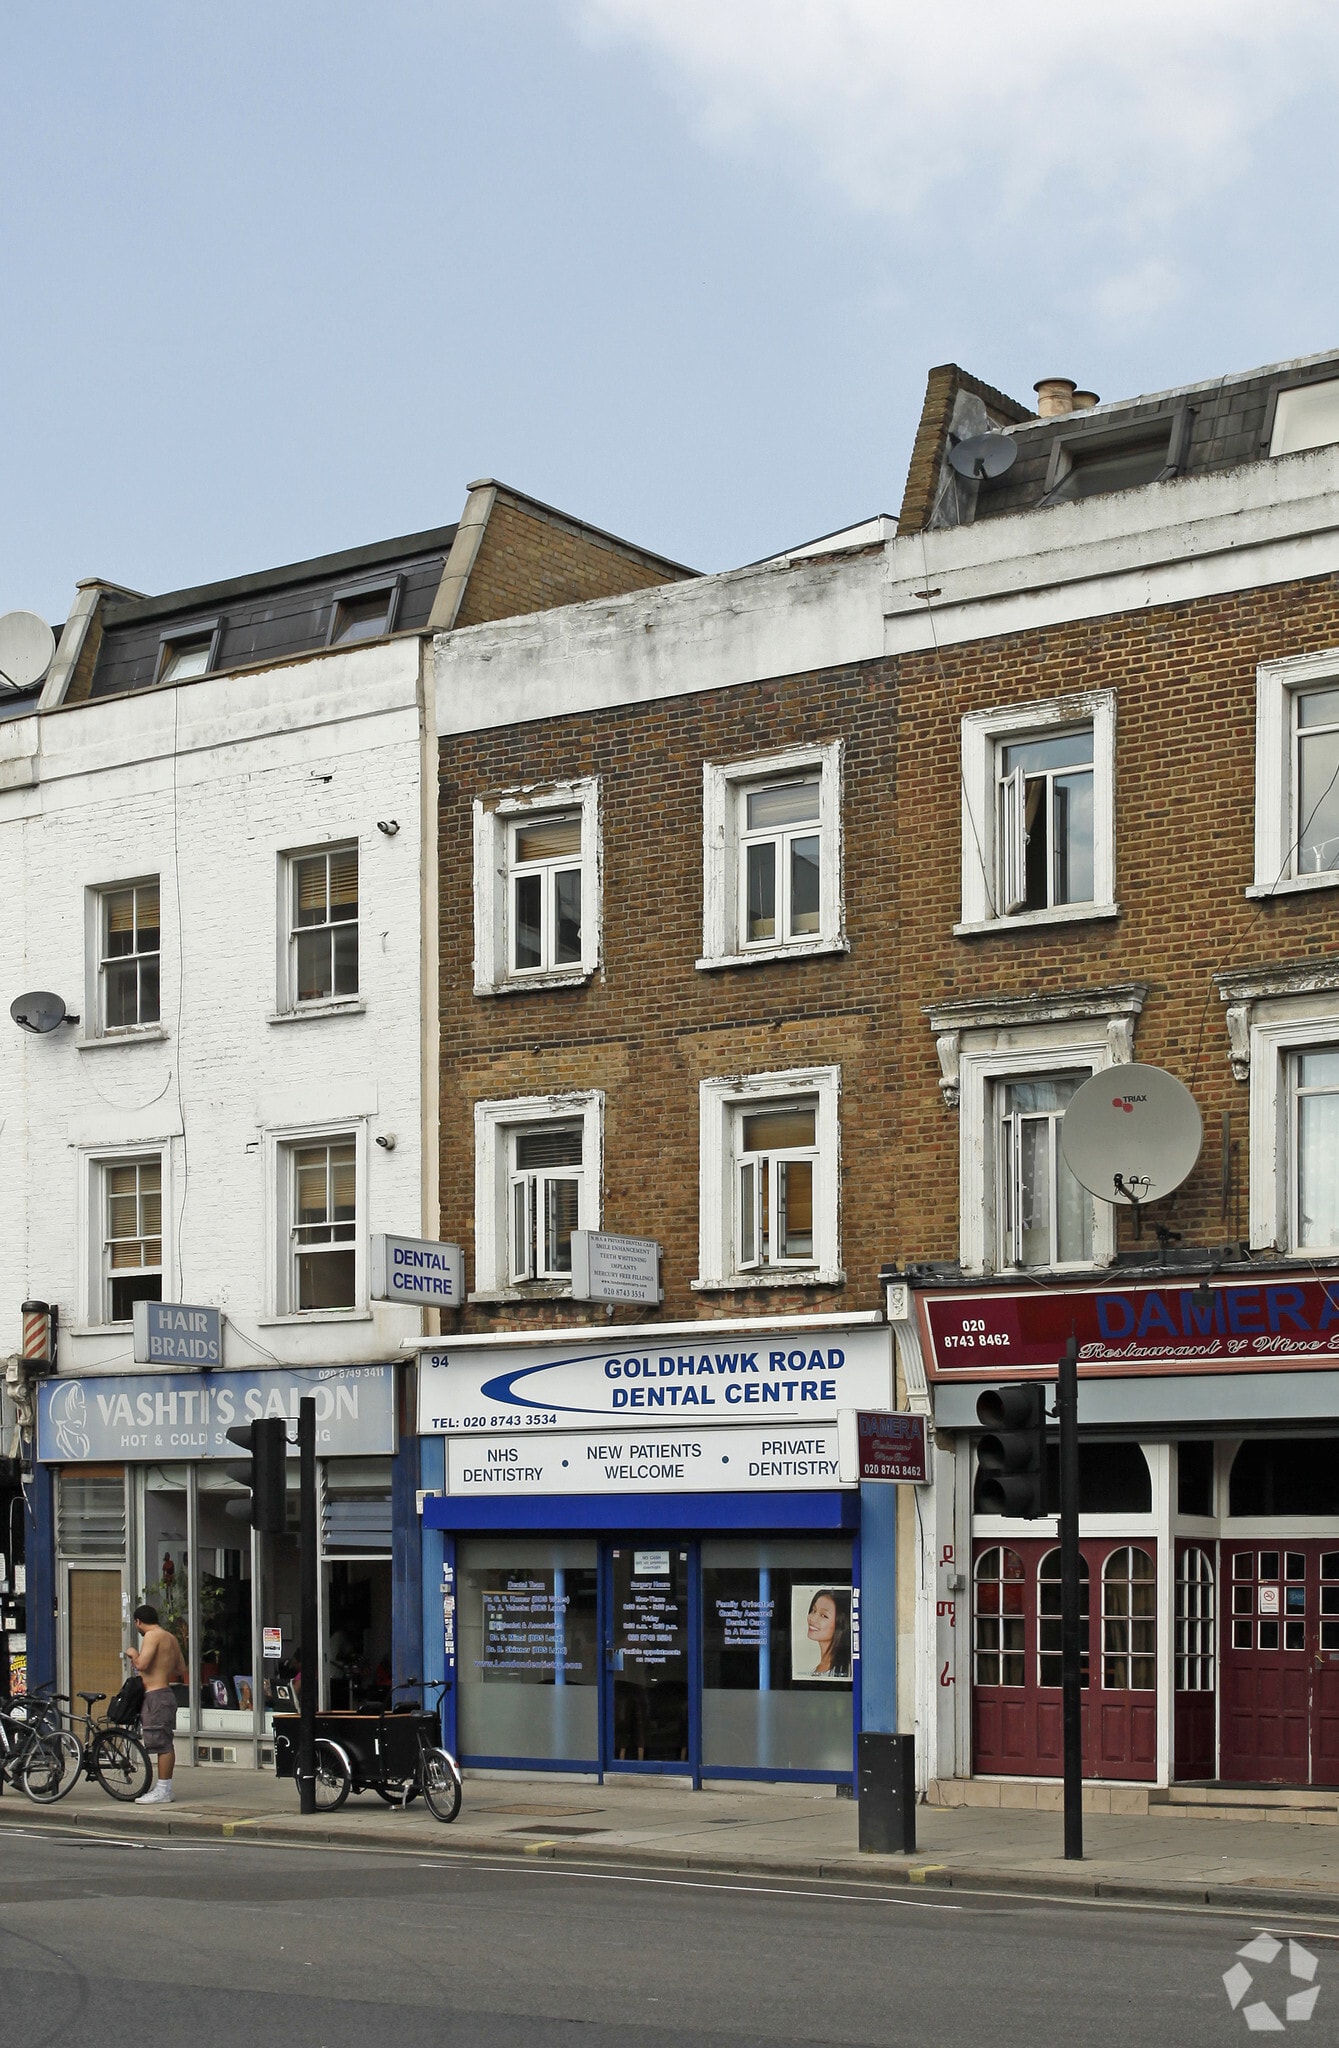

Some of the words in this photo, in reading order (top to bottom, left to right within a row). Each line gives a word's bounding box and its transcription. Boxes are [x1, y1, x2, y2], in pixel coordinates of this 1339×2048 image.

[600, 1252, 616, 1260] TEETH
[618, 1254, 647, 1263] WHITENING
[612, 1246, 650, 1254] ENHANCEMENT
[394, 1248, 450, 1270] DENTAL
[392, 1272, 452, 1295] CENTRE
[594, 1270, 618, 1278] MERCURY
[619, 1272, 631, 1280] FREE
[632, 1274, 654, 1282] FILLINGS
[616, 1288, 630, 1296] 8743
[632, 1290, 646, 1298] 3534
[158, 1310, 208, 1332] HAIR
[962, 1319, 986, 1332] 020
[150, 1336, 219, 1360] BRAIDS
[944, 1334, 975, 1348] 8743
[978, 1333, 1010, 1347] 8462
[1078, 1339, 1222, 1359] Restaurant
[1228, 1339, 1248, 1354] &
[1252, 1336, 1326, 1352] Wine
[431, 1356, 449, 1368] 94
[604, 1352, 759, 1379] GOLDHAWK
[769, 1348, 846, 1372] ROAD
[318, 1370, 336, 1380] 020
[339, 1369, 361, 1379] 8749
[364, 1368, 384, 1377] 3411
[612, 1386, 715, 1408] DENTAL
[725, 1380, 837, 1404] CENTRE
[97, 1390, 236, 1427] VASHTI'S
[244, 1384, 359, 1422] SALON
[432, 1418, 460, 1429] TEL:
[463, 1416, 486, 1428] 020
[490, 1414, 522, 1427] 8743
[525, 1414, 557, 1426] 3534
[860, 1415, 922, 1440] DAMERA
[120, 1434, 148, 1447] HOT
[154, 1434, 164, 1446] &
[170, 1432, 208, 1446] COLD
[487, 1448, 518, 1462] NHS
[587, 1445, 623, 1460] NEW
[629, 1443, 702, 1459] PATIENTS
[762, 1440, 826, 1456] PRIVATE
[463, 1466, 543, 1482] DENTISTRY
[604, 1463, 684, 1478] WELCOME
[748, 1460, 839, 1476] DENTISTRY
[864, 1464, 878, 1474] 020
[881, 1465, 900, 1475] 8743
[902, 1466, 921, 1476] 8462
[716, 1600, 738, 1608] Family
[741, 1600, 774, 1608] Oriented
[718, 1610, 743, 1618] Quality
[726, 1618, 748, 1626] Dental
[749, 1618, 766, 1626] Care
[489, 1634, 499, 1642] Dr.
[740, 1628, 767, 1636] Relaxed
[724, 1636, 768, 1644] Environment
[505, 1646, 530, 1654] Skinner
